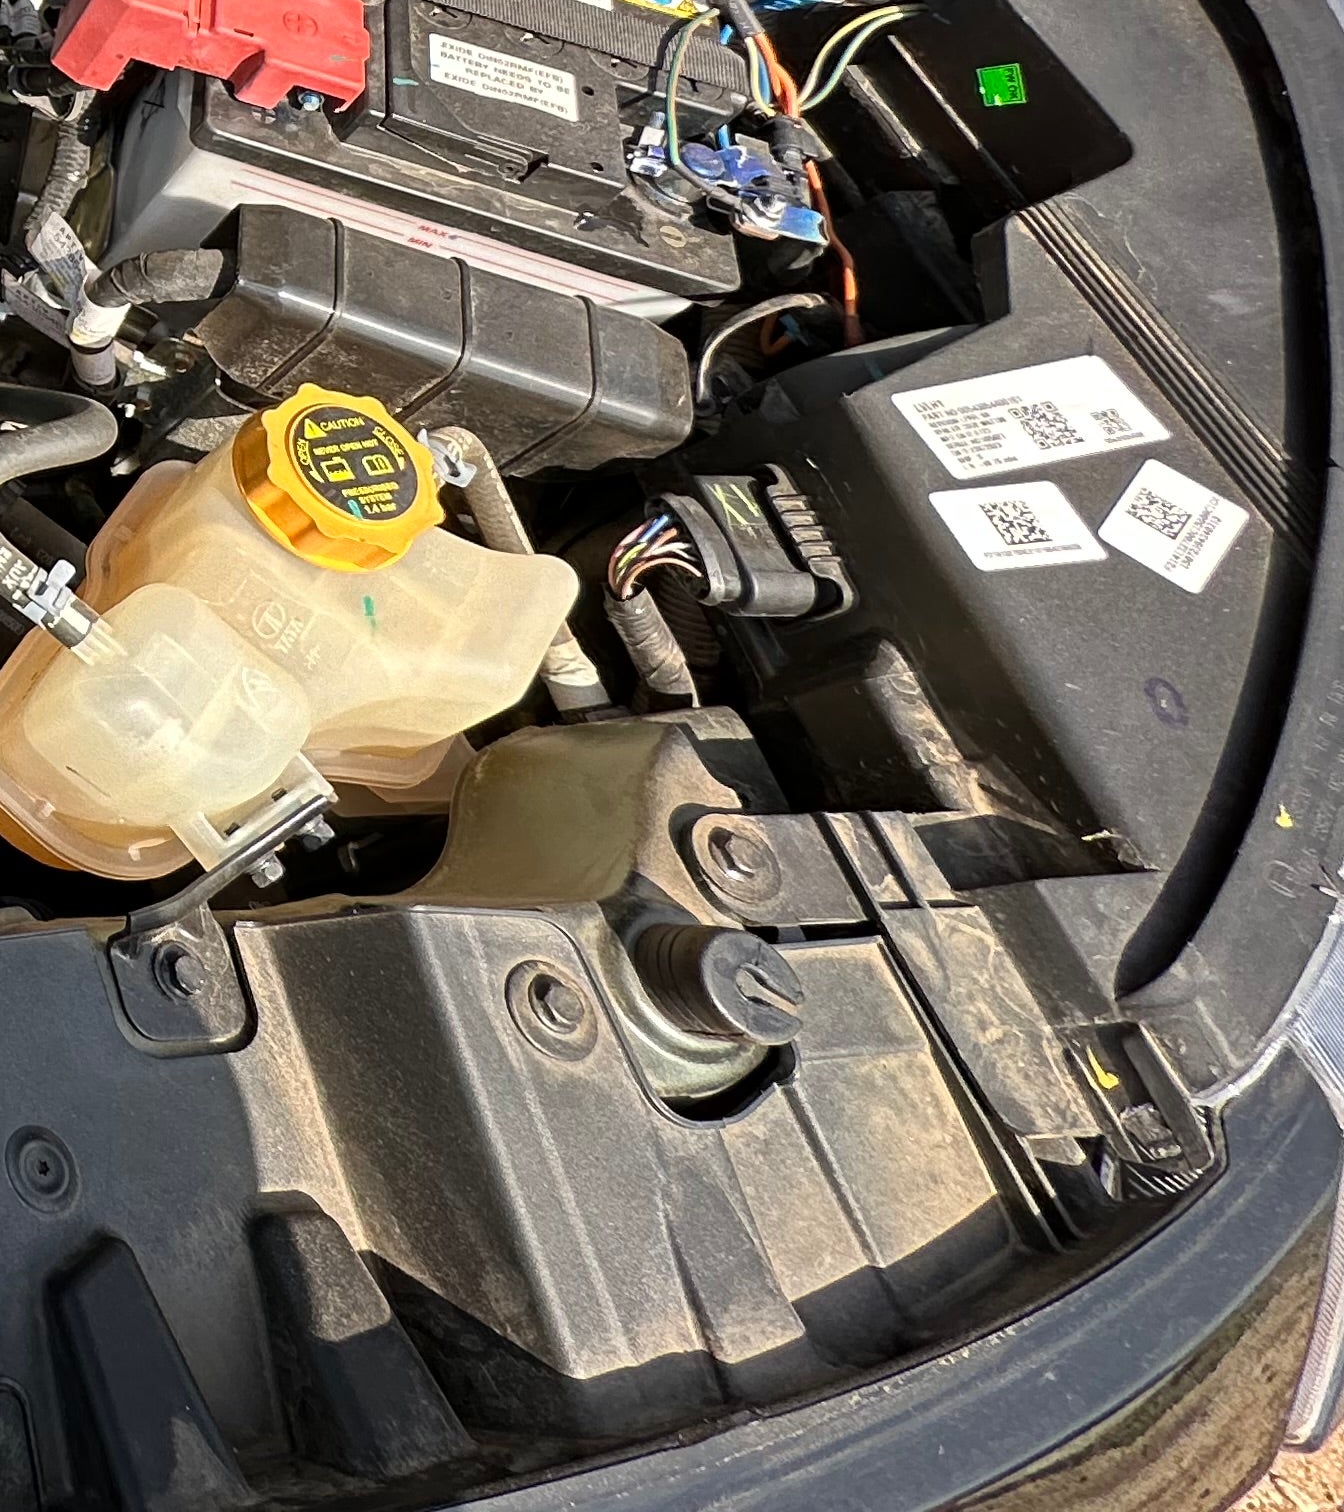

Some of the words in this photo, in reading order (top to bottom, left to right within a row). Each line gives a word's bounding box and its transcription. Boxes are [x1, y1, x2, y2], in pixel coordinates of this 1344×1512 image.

[440, 41, 473, 56] EXIDE
[440, 51, 488, 69] BATTERY
[494, 67, 532, 83] NEEDS
[538, 79, 552, 89] TO
[556, 85, 570, 95] BE
[444, 72, 476, 86] EXIDE
[465, 67, 525, 89] REPLACED
[530, 85, 544, 95] BY
[418, 225, 449, 237] MAX
[408, 237, 433, 248] MIN
[319, 417, 365, 431] CAUTION
[313, 445, 340, 456] NEVER
[340, 441, 363, 452] OPEN
[361, 438, 379, 448] HOT
[271, 616, 305, 655] TATA
